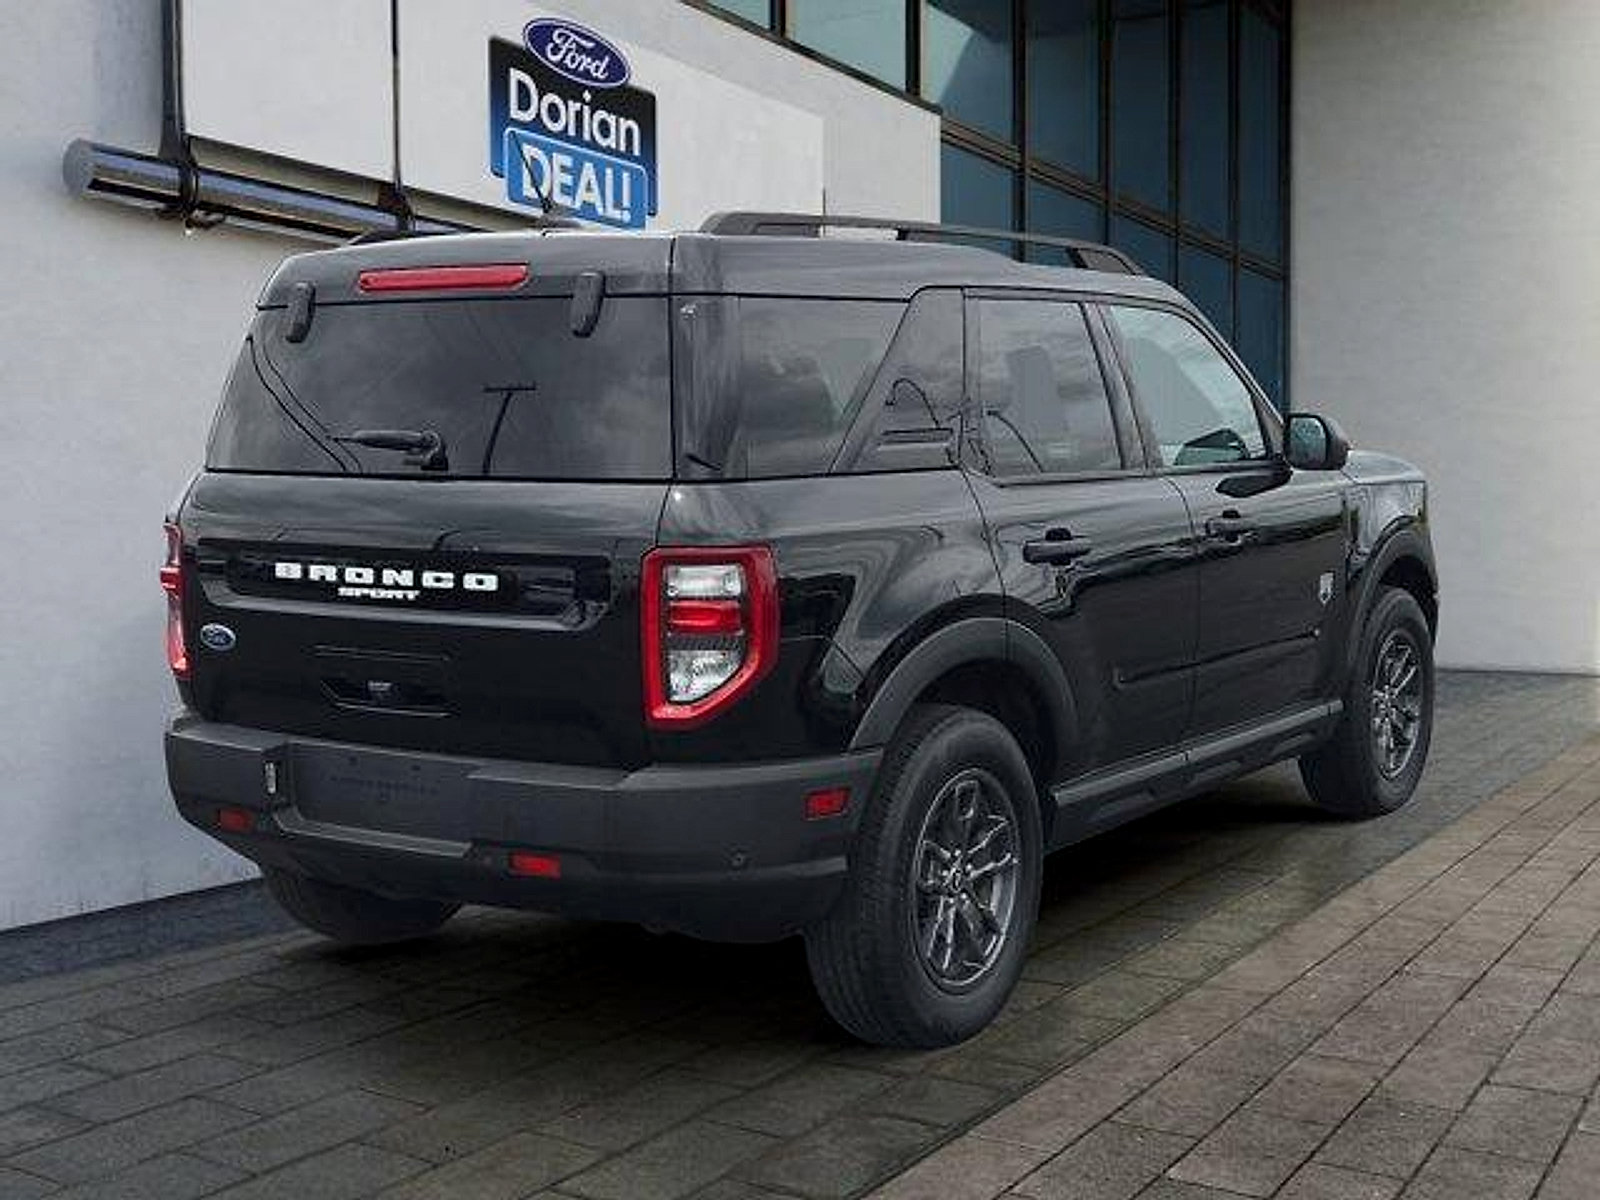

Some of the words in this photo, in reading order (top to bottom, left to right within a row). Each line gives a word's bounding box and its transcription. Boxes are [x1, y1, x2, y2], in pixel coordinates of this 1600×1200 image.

[547, 28, 609, 79] Ford
[509, 67, 641, 156] Dorian
[521, 143, 631, 223] DEAL!
[275, 562, 498, 591] BRONCO
[338, 587, 420, 600] SPORT
